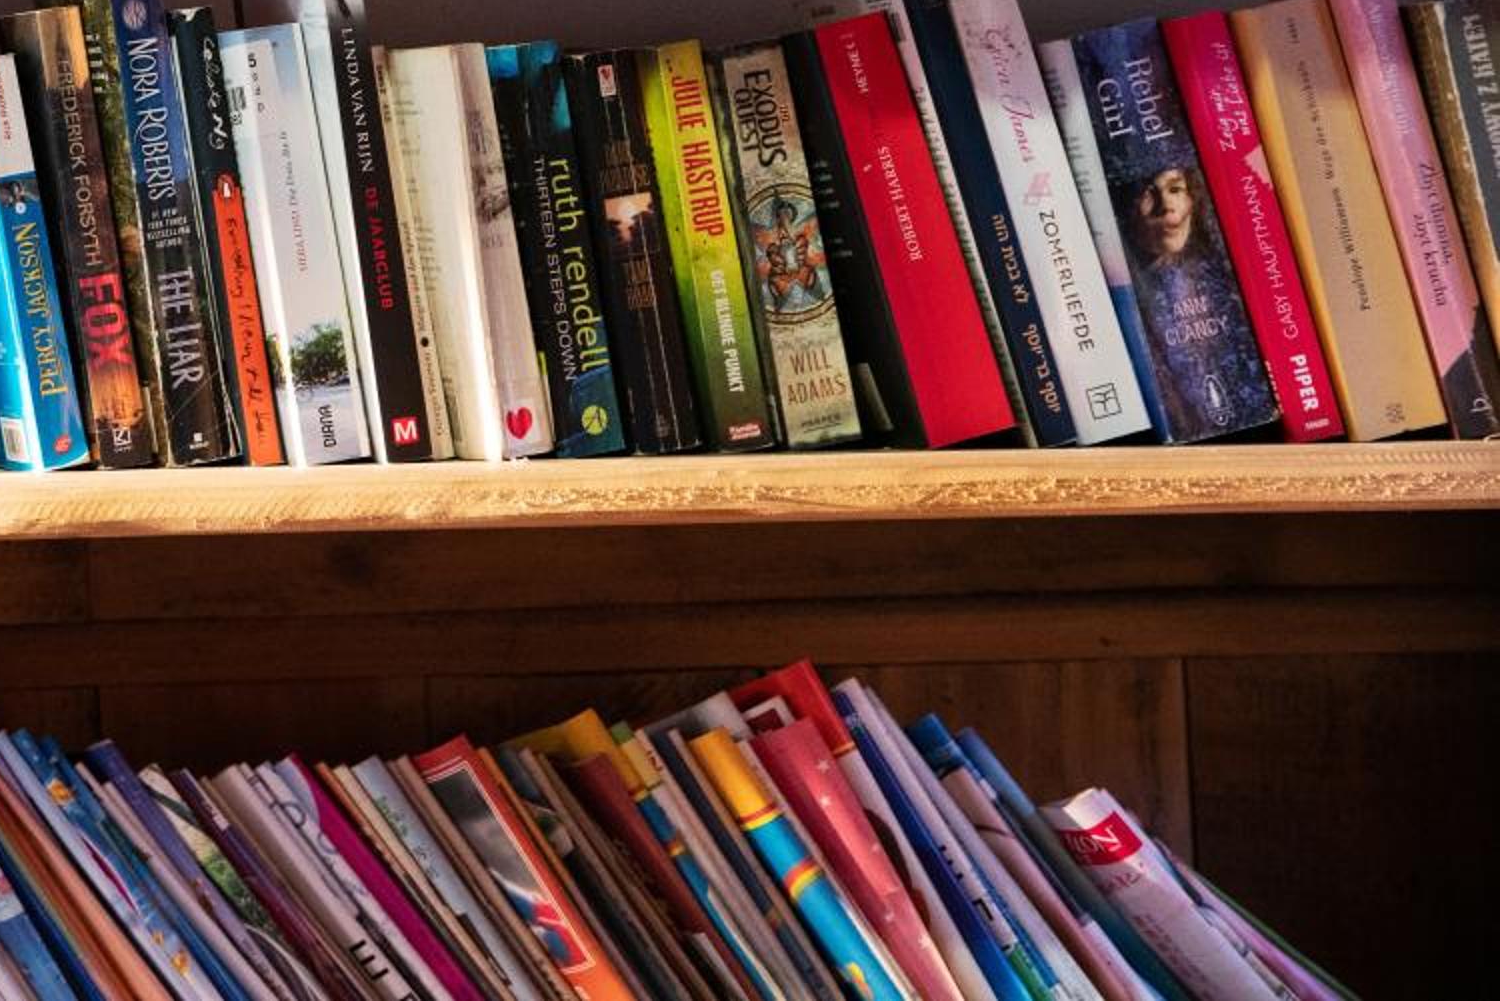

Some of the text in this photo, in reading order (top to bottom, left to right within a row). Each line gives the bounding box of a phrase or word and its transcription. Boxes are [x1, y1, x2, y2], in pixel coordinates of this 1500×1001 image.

[126, 38, 177, 210] NORA ROBERTS
[734, 89, 761, 153] QUEST
[743, 68, 787, 168] EXODUS
[1001, 95, 1038, 164] James
[1097, 77, 1134, 140] Girl
[1123, 55, 1174, 144] Rebel
[57, 59, 102, 266] FREDERICK FORSYTH
[339, 26, 395, 311] LINDA VAN RIJN DE JAARCLUB
[671, 75, 724, 237] JULIE HASTRUP
[878, 145, 923, 262] ROBERT HARRIS
[1333, 187, 1362, 251] Williamson
[534, 157, 577, 382] THIRTEEN STEPS DOWN
[549, 157, 609, 372] ruth rendell
[1039, 208, 1096, 353] ZOMERLIEFDE
[1244, 174, 1301, 340] GABY HAUPTMANN
[1347, 253, 1371, 311] Penelope
[1424, 249, 1448, 308] krucha
[14, 221, 68, 398] PERCY JACKSON
[78, 273, 129, 370] FOX
[156, 269, 207, 390] THE LIAR
[1165, 313, 1230, 346] CLANCY
[1172, 296, 1207, 319] ANN
[723, 351, 744, 393] PUNKT
[786, 375, 847, 408] ADAMS
[790, 348, 832, 377] WILL
[1288, 354, 1320, 414] PIPER
[322, 403, 339, 449] DIANA
[393, 419, 419, 443] M
